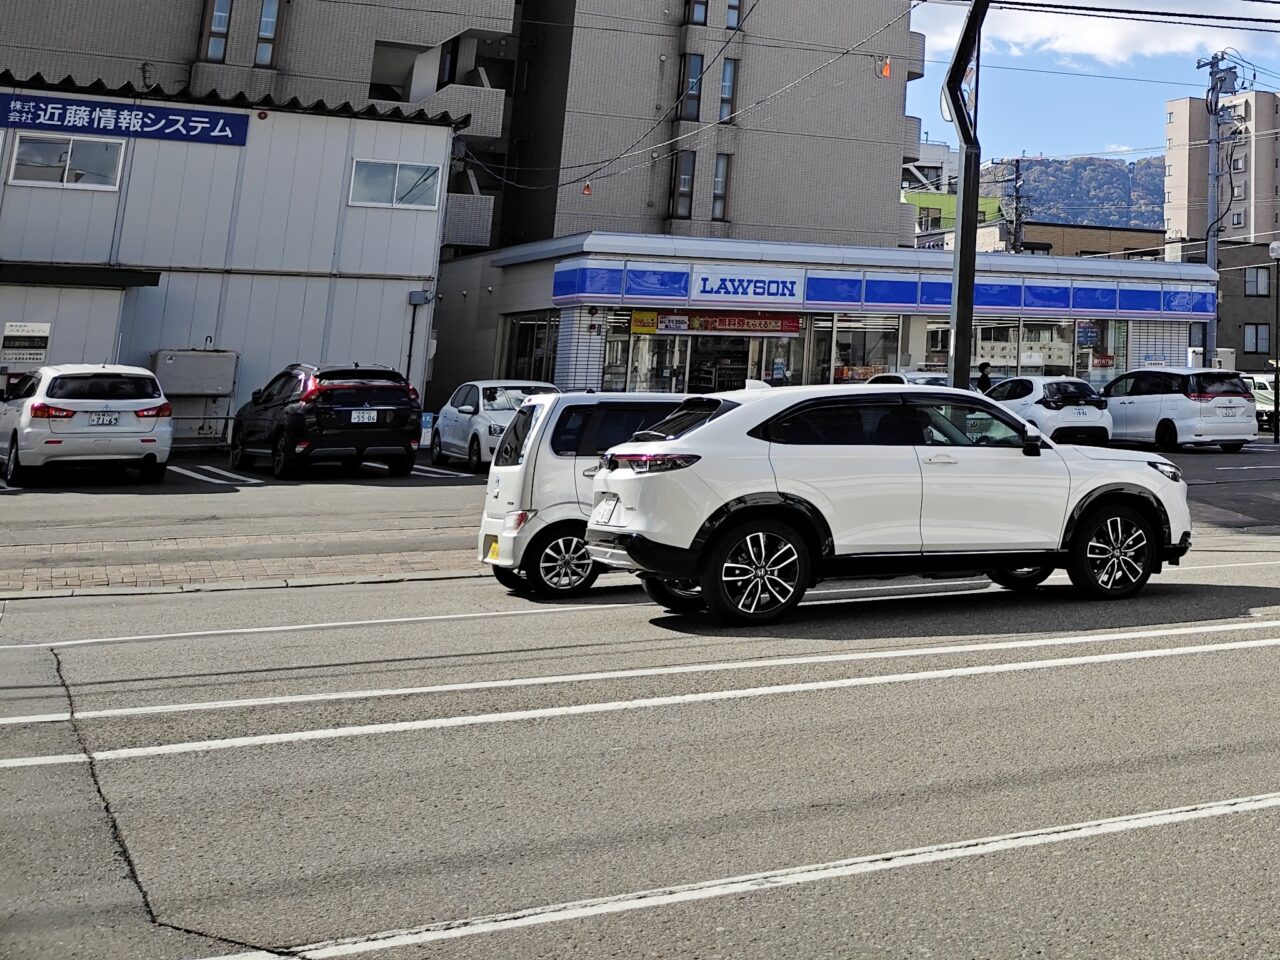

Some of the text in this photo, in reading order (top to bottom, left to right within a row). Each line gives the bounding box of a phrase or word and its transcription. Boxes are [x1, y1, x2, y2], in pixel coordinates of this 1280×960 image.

[36, 102, 233, 139] 近藤情報システム
[700, 277, 797, 297] LAWSON
